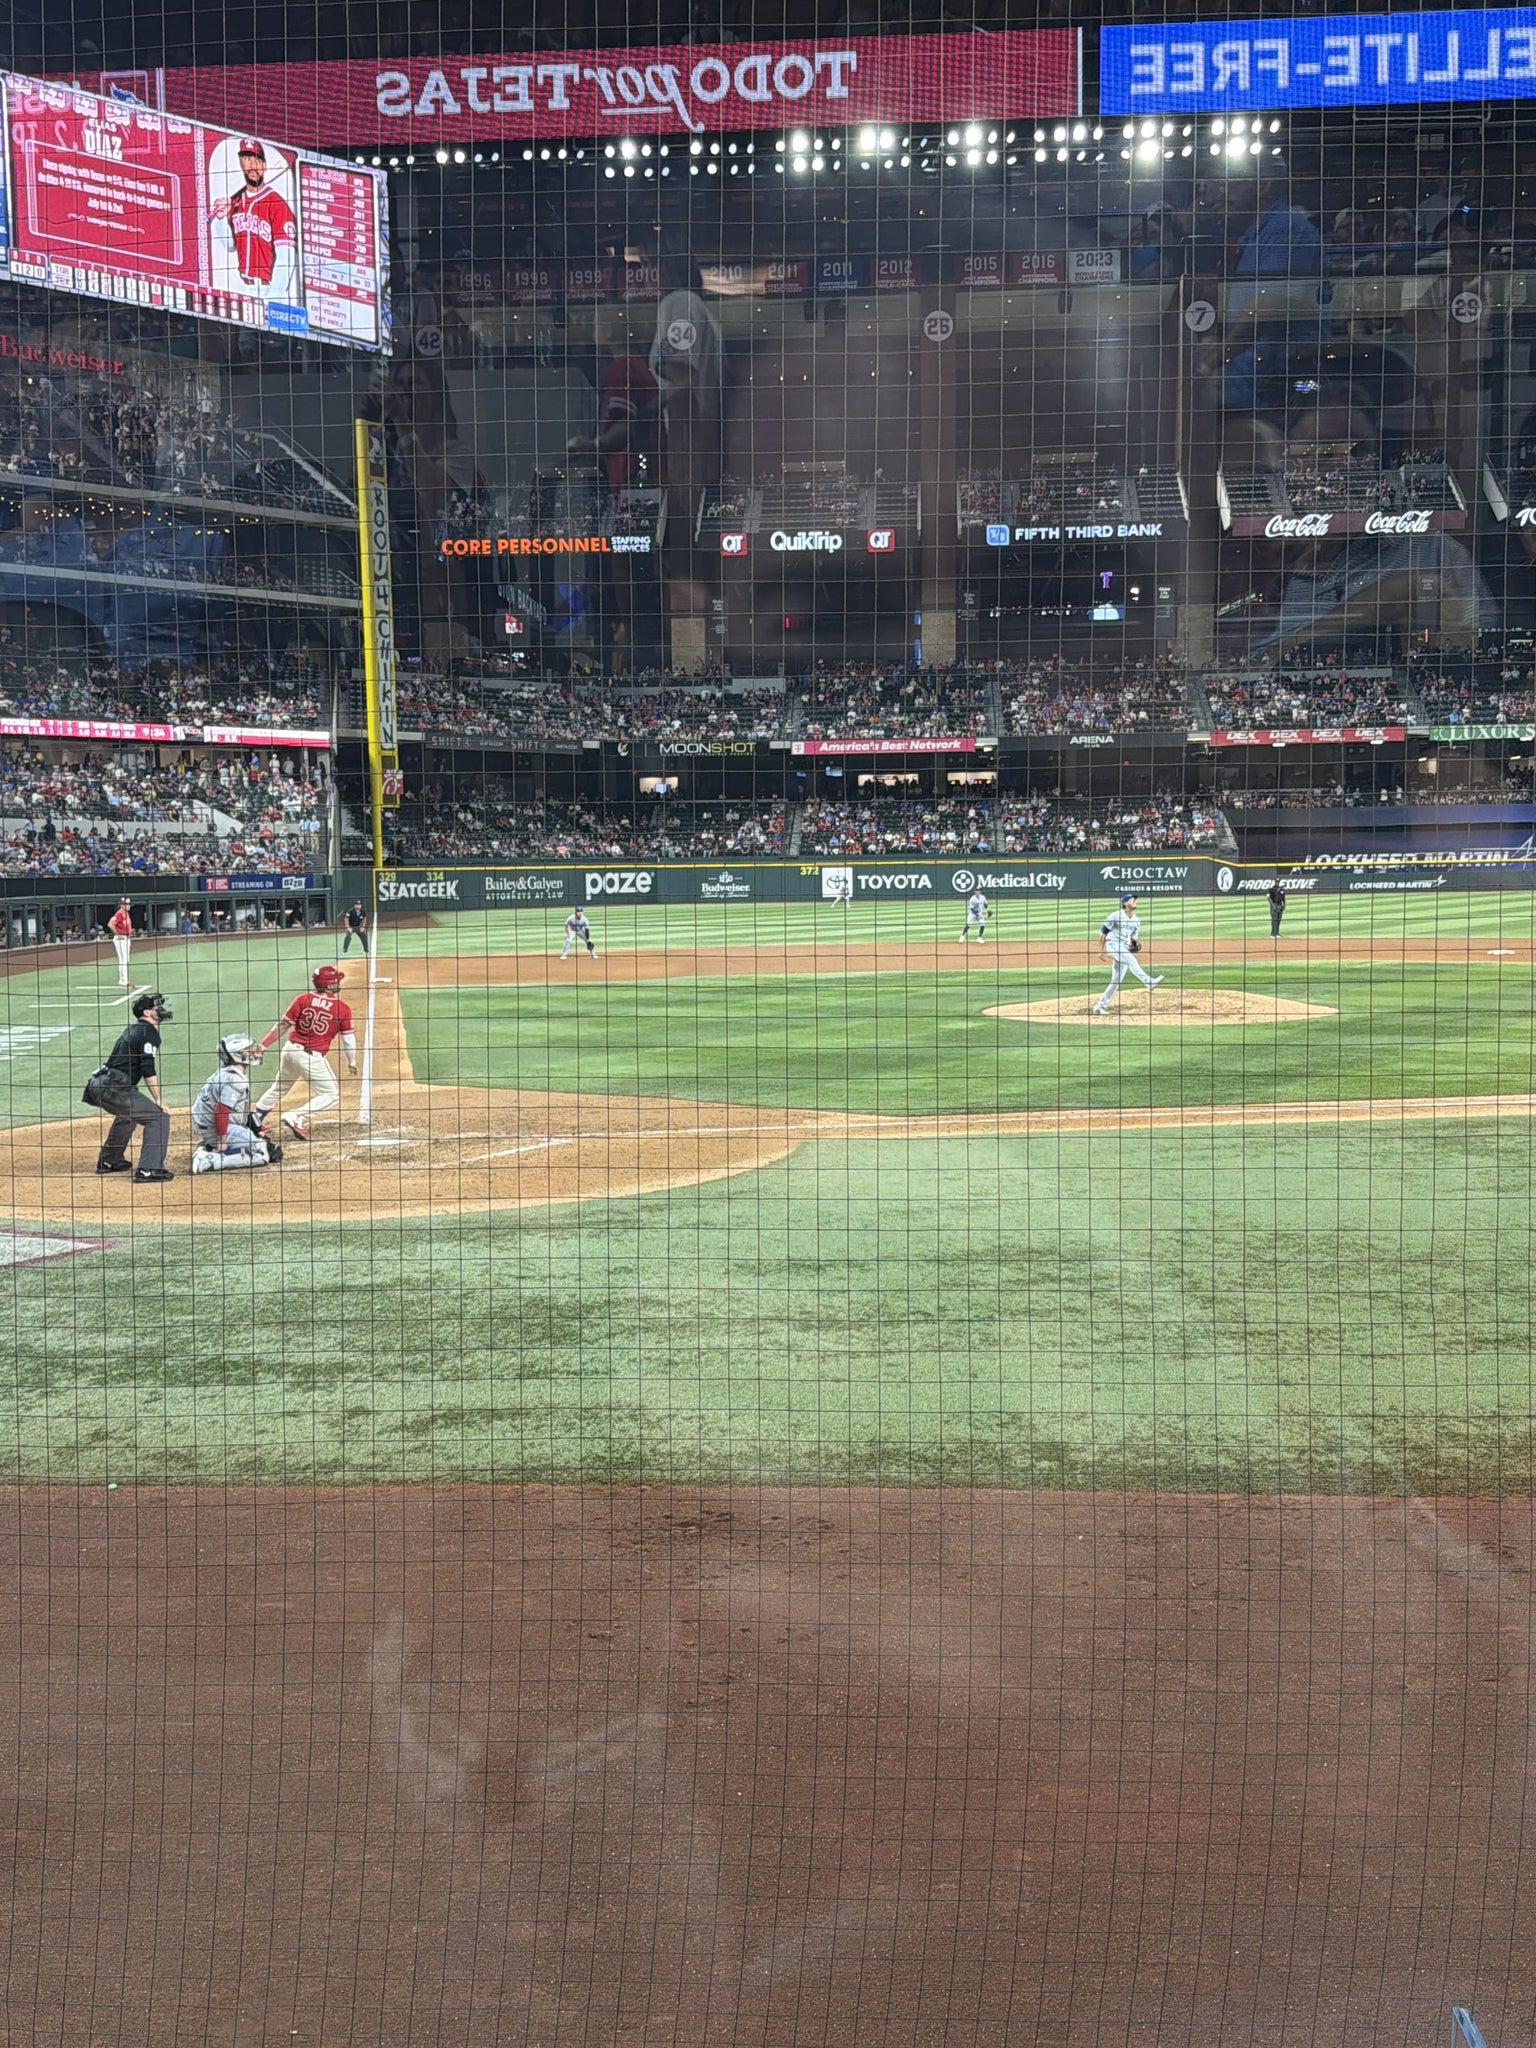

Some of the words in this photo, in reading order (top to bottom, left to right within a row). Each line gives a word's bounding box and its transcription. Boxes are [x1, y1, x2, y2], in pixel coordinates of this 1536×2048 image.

[88, 118, 117, 132] ELIAS
[964, 256, 997, 271] 2015
[1022, 255, 1055, 270] 2016
[1076, 252, 1113, 267] 2023
[25, 265, 31, 275] 2
[710, 265, 742, 279] 2010
[768, 263, 798, 279] 2011
[823, 262, 852, 277] 2011
[880, 260, 913, 274] 2012
[459, 273, 492, 287] 1996
[515, 271, 548, 286] 1998
[569, 270, 602, 284] 1999
[626, 268, 659, 283] 2010
[960, 278, 1000, 286] CHAMPIONS
[1194, 307, 1208, 326] 7
[927, 317, 950, 335] 26
[418, 332, 441, 349] 42
[670, 325, 694, 344] 34
[1265, 513, 1333, 538] Coca-Cola
[1365, 510, 1433, 535] Coca-Cola
[1015, 527, 1060, 541] FIFTH
[1065, 525, 1114, 539] THIRD
[1117, 523, 1162, 538] BANK
[441, 539, 491, 555] CORE
[497, 537, 611, 554] PERSONNEL
[611, 536, 650, 545] STAFFING
[722, 535, 743, 553] QT
[770, 531, 843, 553] QuikTrip
[869, 531, 891, 549] QT
[612, 544, 650, 553] SERVICES
[1227, 731, 1257, 740] DEX
[1269, 730, 1300, 739] DEX
[1312, 729, 1342, 738] DEX
[1355, 728, 1386, 737] DEX
[431, 736, 461, 747] SHIFT
[511, 740, 539, 750] SHIFT
[819, 740, 879, 752] America's
[881, 741, 908, 750] Best
[909, 740, 961, 750] Network
[1069, 735, 1114, 745] ARENA
[659, 742, 757, 754] MOONSHOT
[379, 872, 396, 881] 329
[426, 872, 444, 881] 334
[800, 867, 819, 876] 372
[1110, 866, 1188, 879] CHOCTAW
[231, 881, 264, 889] STREAMING
[585, 871, 653, 900] paze
[701, 883, 750, 892] Budweiser
[857, 874, 932, 889] TOYOTA
[977, 873, 1035, 888] Medical
[1036, 873, 1066, 891] City
[1350, 881, 1395, 890] LOCKHEED
[1397, 881, 1433, 889] MARTIN
[378, 880, 460, 901] SEATGEEK
[485, 892, 531, 900] ATTORNEYS
[535, 891, 544, 899] AT
[548, 891, 563, 899] LAW
[299, 1007, 333, 1036] 35
